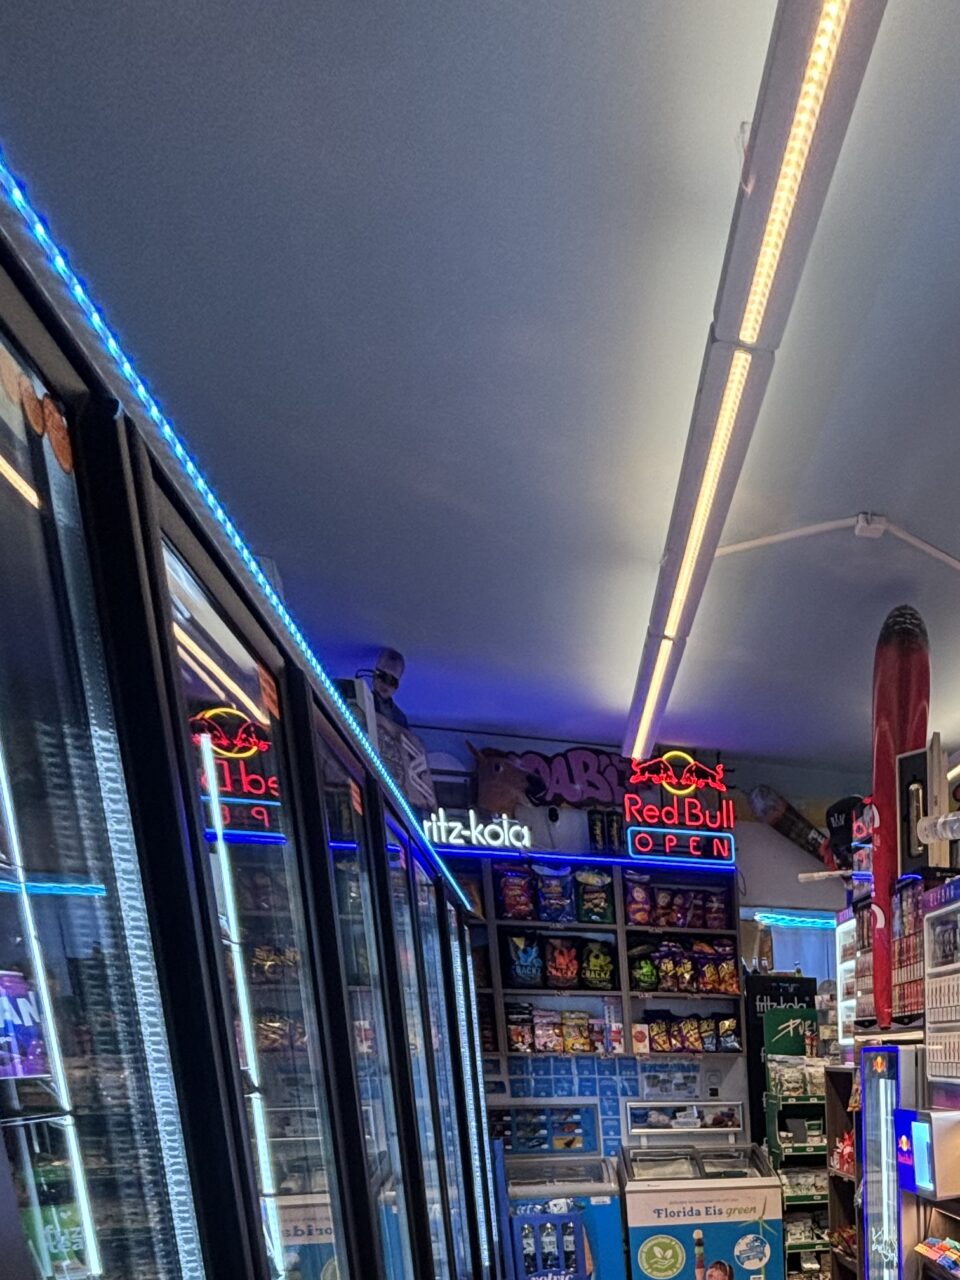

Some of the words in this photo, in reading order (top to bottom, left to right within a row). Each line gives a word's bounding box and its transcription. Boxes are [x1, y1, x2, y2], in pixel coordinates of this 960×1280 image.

[624, 794, 678, 825] Red
[684, 798, 735, 829] Bull
[635, 832, 729, 857] OPEN
[652, 1206, 702, 1219] Florida
[704, 1204, 724, 1216] Eis
[725, 1206, 757, 1219] green
